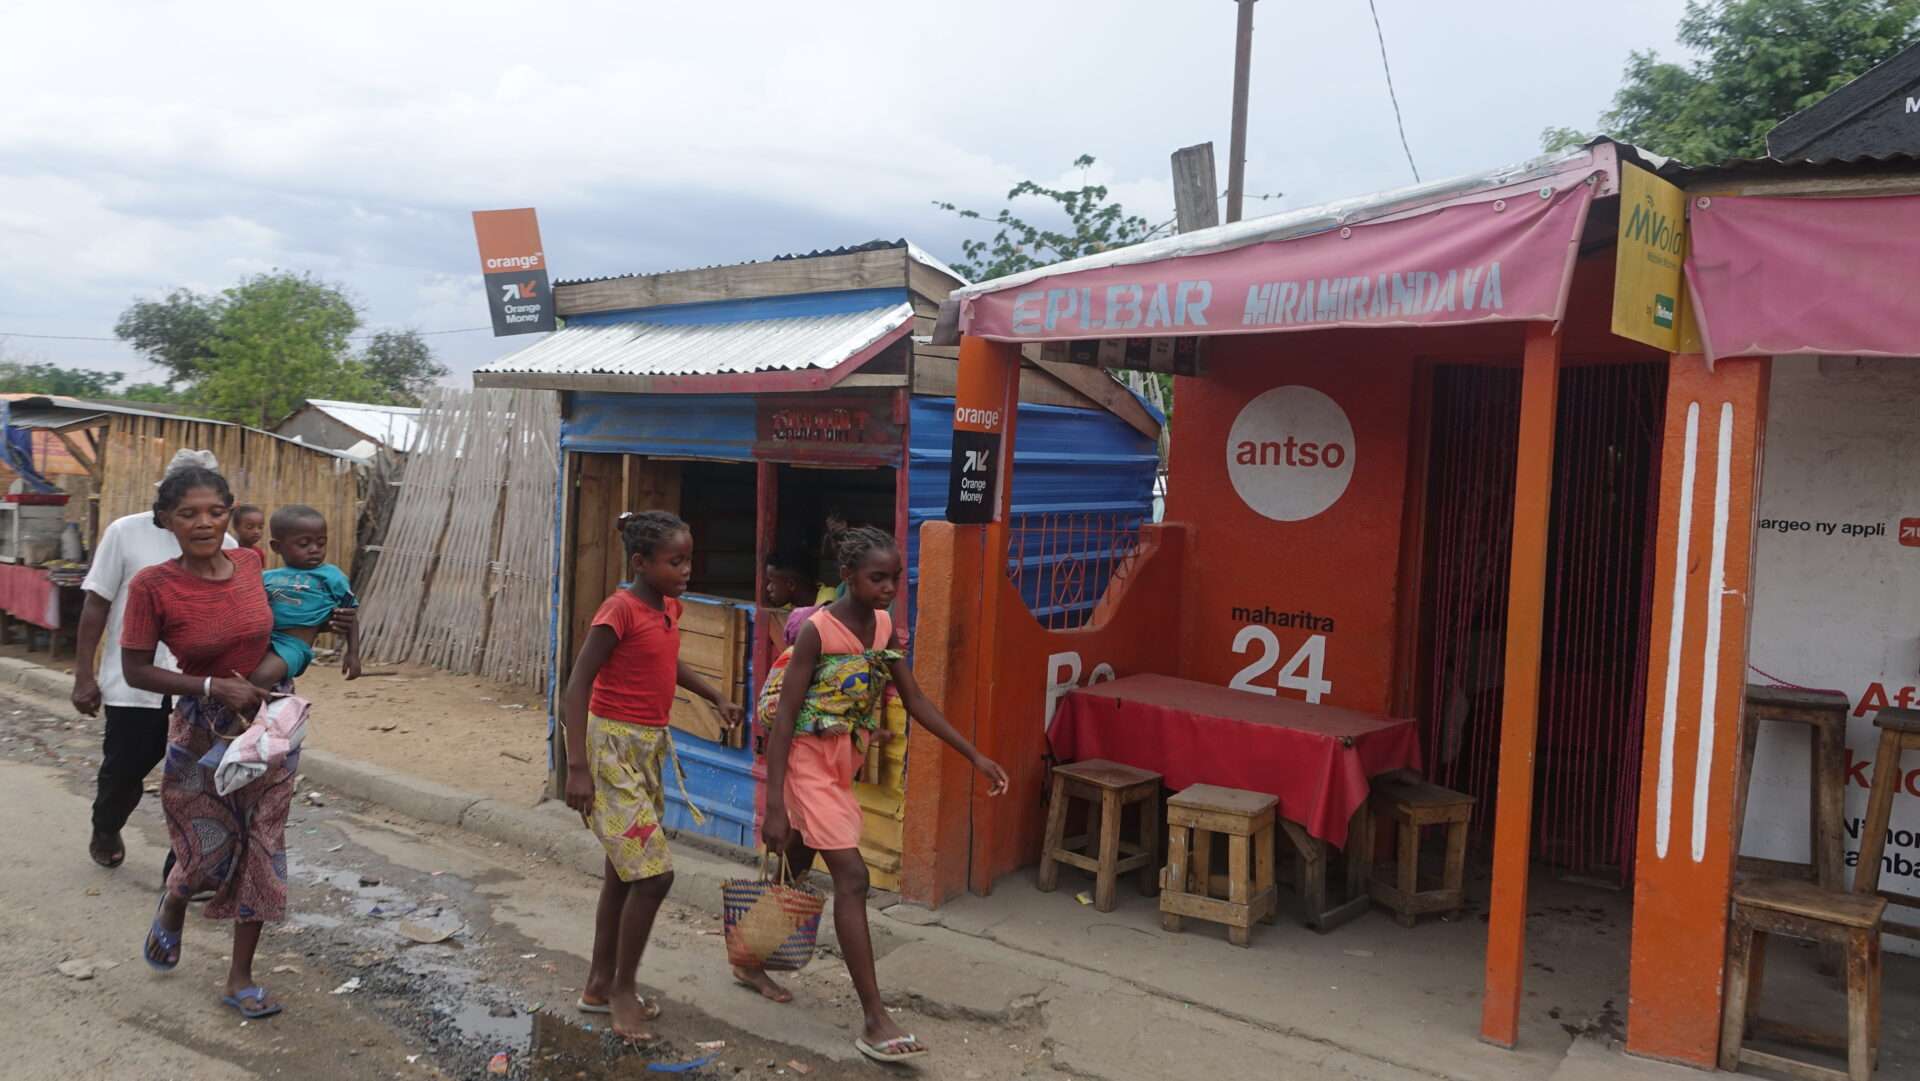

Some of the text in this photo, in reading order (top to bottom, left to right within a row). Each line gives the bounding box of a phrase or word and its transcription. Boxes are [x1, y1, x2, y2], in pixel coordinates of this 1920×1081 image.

[487, 255, 538, 269] orange
[504, 304, 541, 313] Orange
[505, 314, 539, 323] Money
[956, 407, 998, 429] orange
[1236, 436, 1345, 468] antso
[961, 477, 986, 491] Orange
[960, 490, 983, 504] Money
[1815, 522, 1837, 535] ny
[1841, 523, 1886, 538] appli
[1231, 606, 1334, 632] maharitra
[1228, 624, 1332, 704] 24
